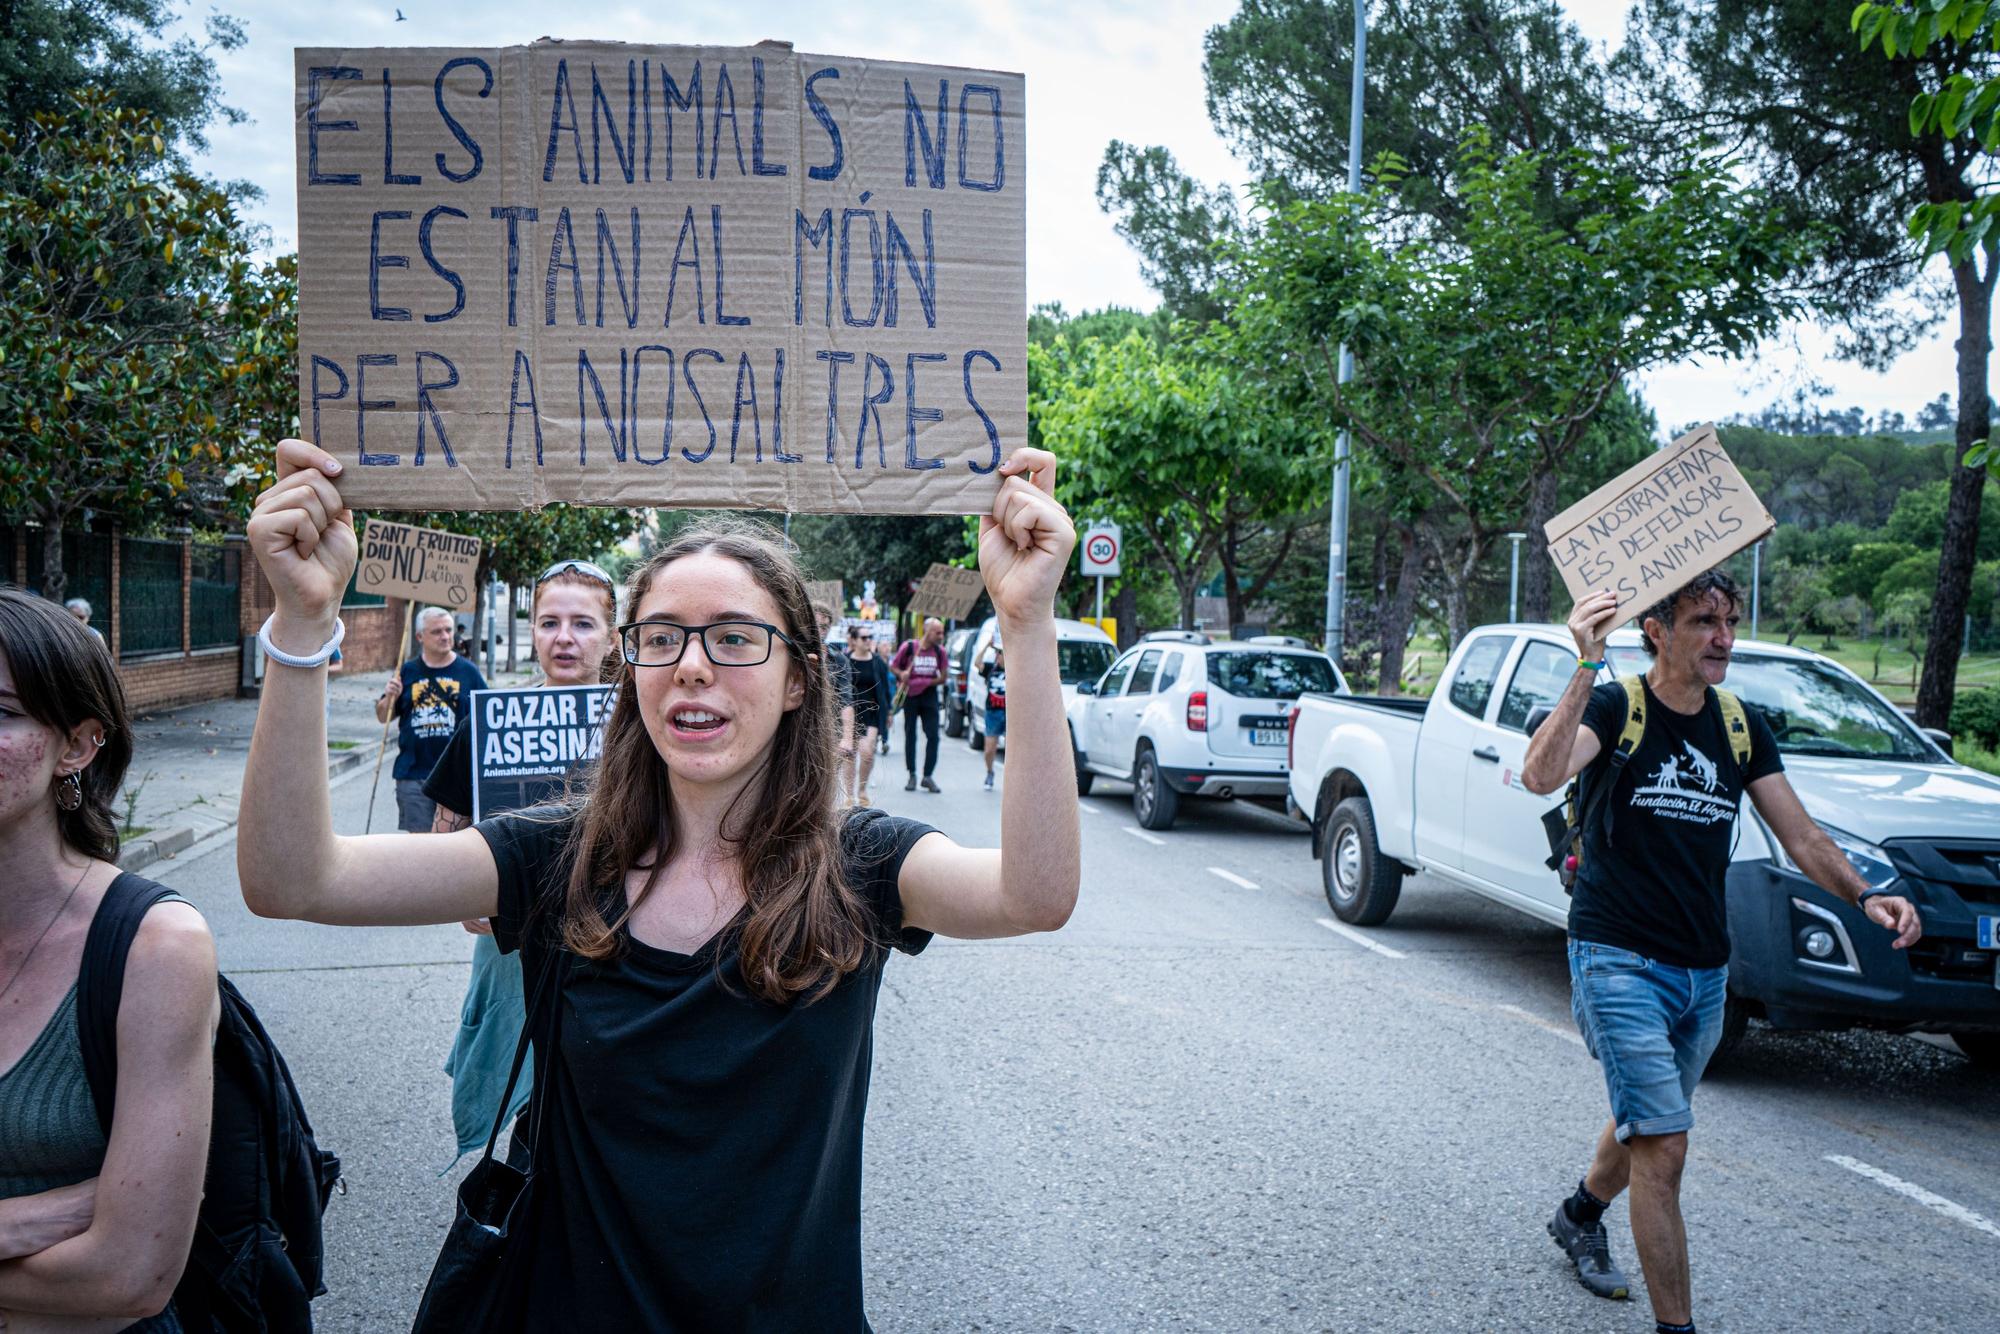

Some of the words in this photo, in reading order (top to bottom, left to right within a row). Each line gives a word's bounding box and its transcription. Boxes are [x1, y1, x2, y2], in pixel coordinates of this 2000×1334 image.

[308, 57, 494, 186] ELS
[543, 56, 846, 185] ANIMALS
[903, 77, 1006, 192] NO
[369, 204, 640, 329] ESTAN
[664, 204, 751, 328] AL
[795, 190, 937, 329] MÓN
[311, 351, 460, 467] PER
[505, 350, 544, 469] A
[579, 345, 1001, 474] NOSALTRES
[1553, 537, 1592, 568] LA
[1587, 486, 1667, 544] NOSTRA
[1652, 448, 1730, 497] FEINA
[368, 524, 411, 545] SANT
[1093, 544, 1111, 556] 30
[1578, 551, 1615, 587] ÉS
[1619, 475, 1739, 560] DEFENSAR
[1640, 506, 1743, 587] ANIMALS
[366, 542, 393, 561] DIU
[392, 545, 426, 584] NO
[486, 693, 578, 730] CAZAR
[483, 765, 566, 778] AnimaNaturalis.org
[1630, 793, 1688, 810] Fundación
[1688, 799, 1701, 812] El
[1653, 808, 1679, 818] Animal
[1679, 811, 1712, 826] Sanctuary
